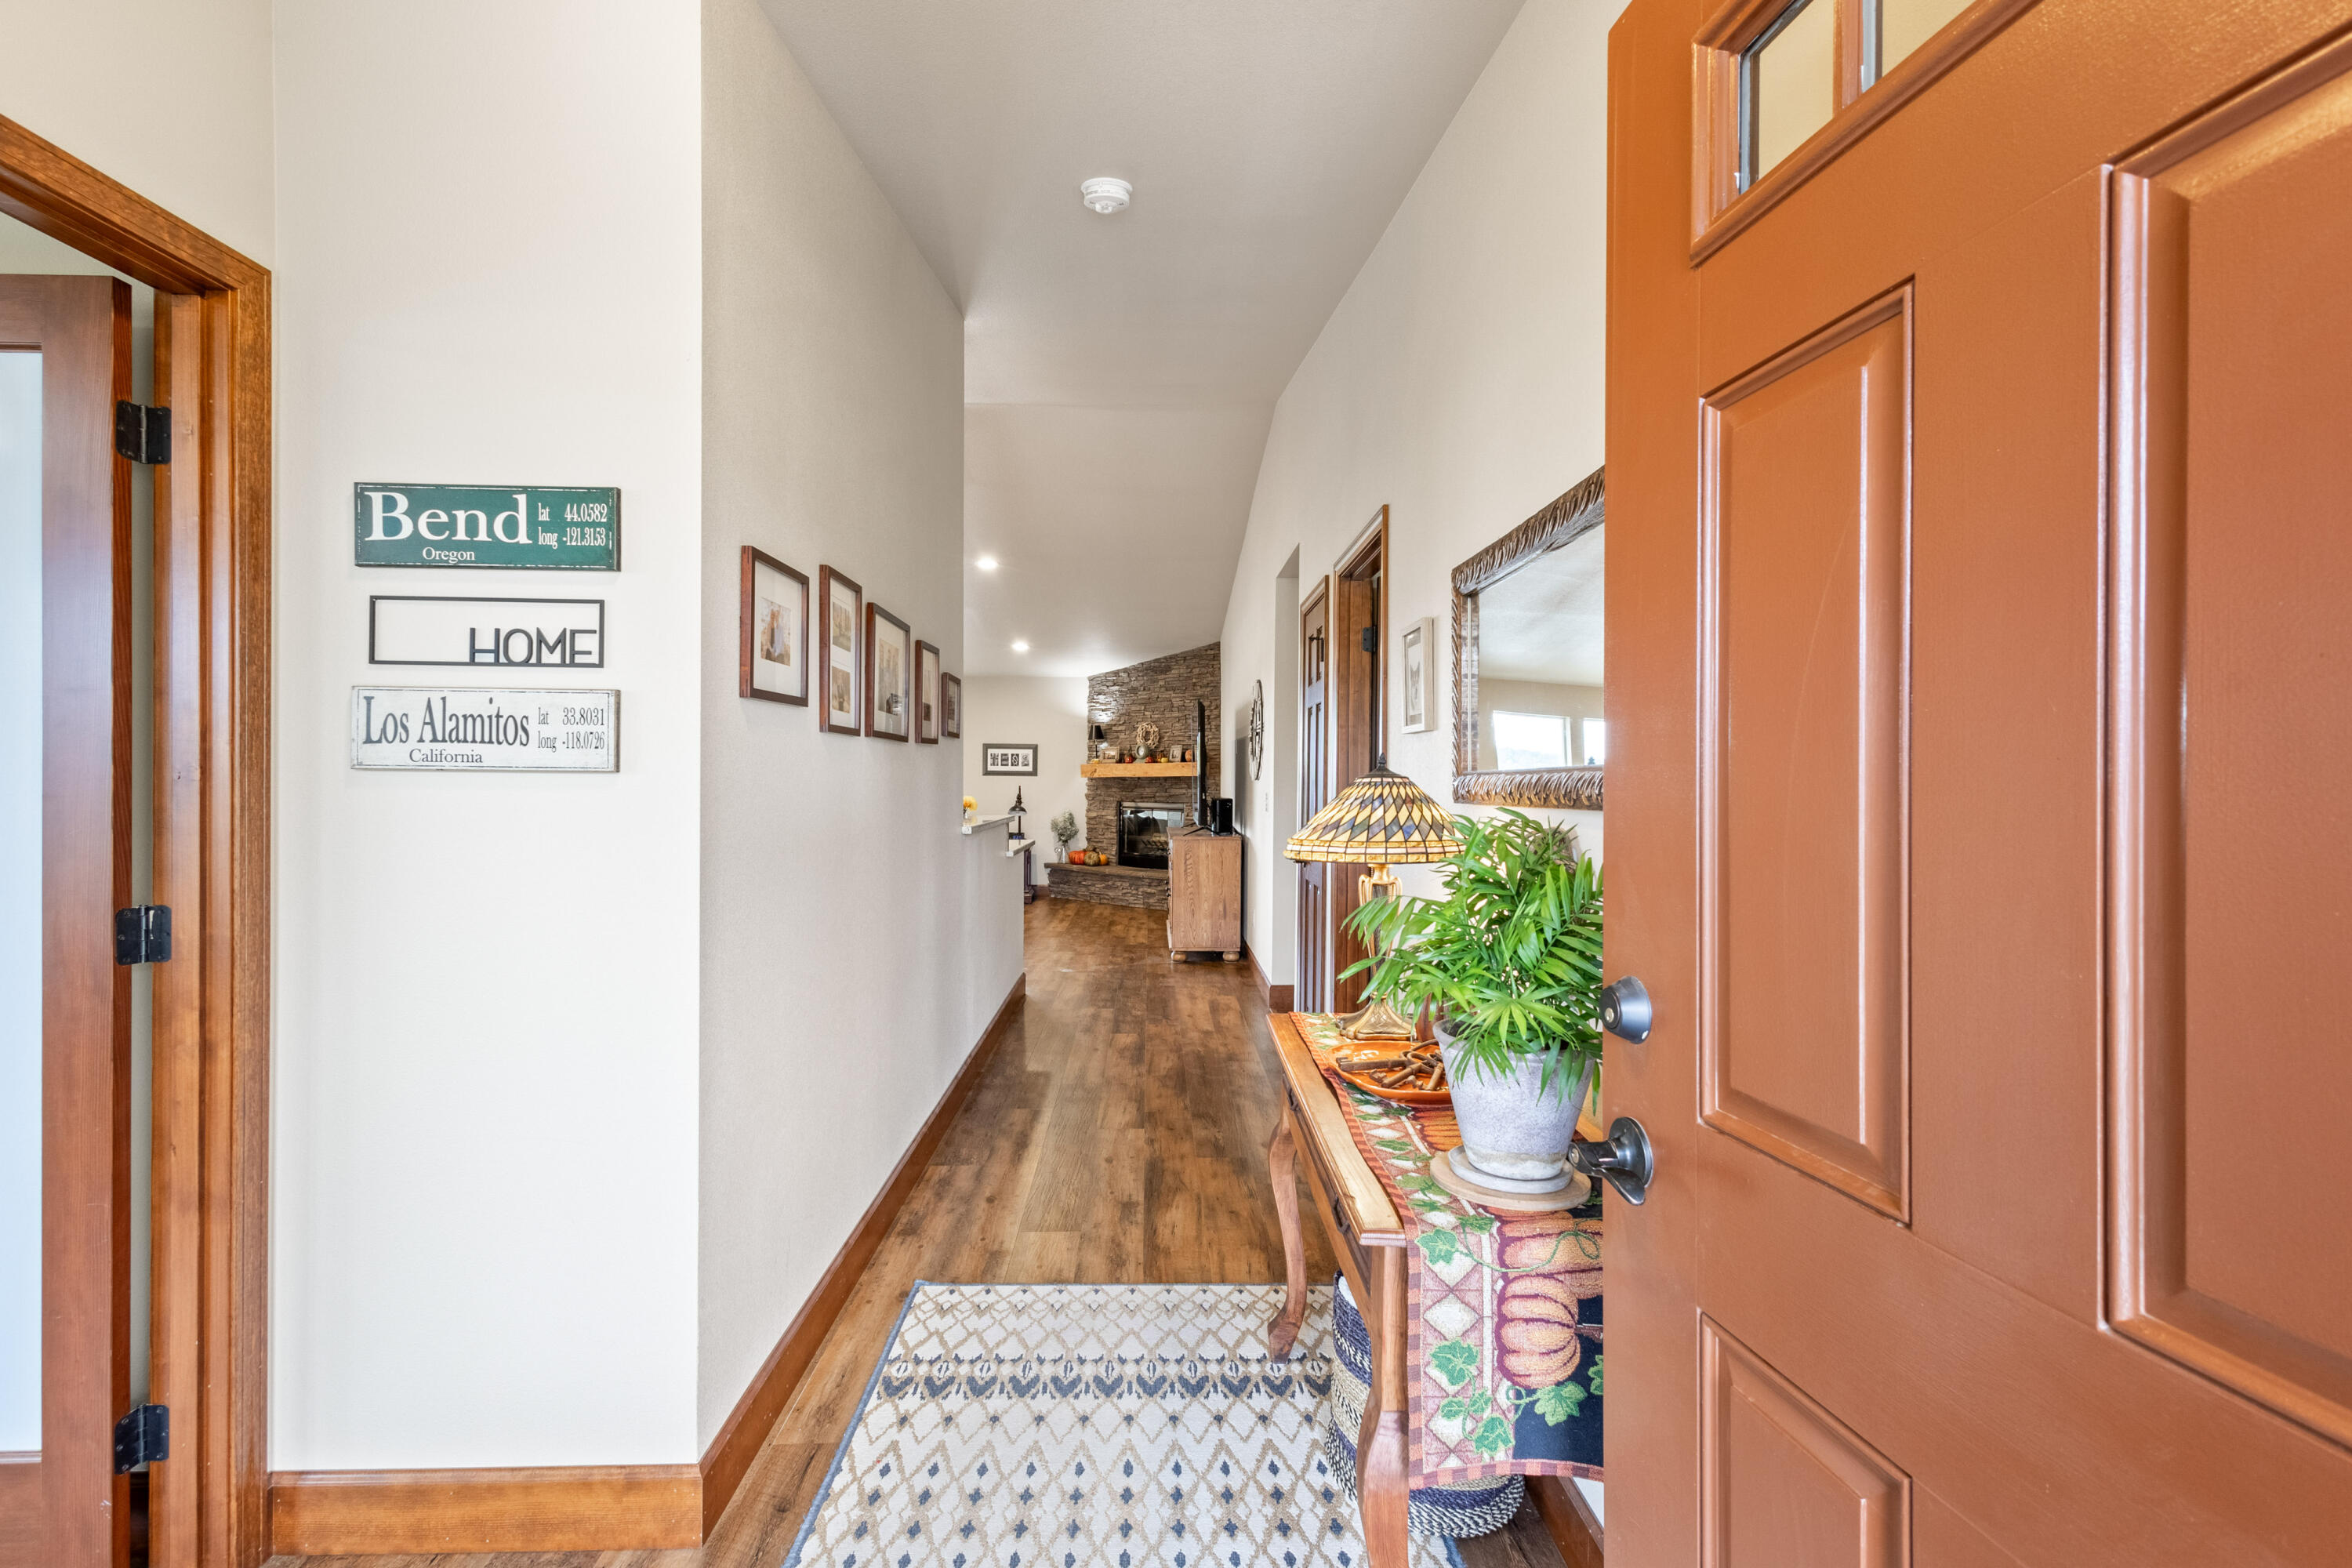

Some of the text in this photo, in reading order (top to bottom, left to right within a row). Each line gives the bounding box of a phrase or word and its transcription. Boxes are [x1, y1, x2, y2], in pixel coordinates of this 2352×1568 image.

[364, 491, 533, 545] Bend
[538, 502, 608, 522] lat 44.0582
[538, 526, 606, 550] long -121.3153
[422, 546, 476, 564] Oregon
[470, 627, 597, 666] HOME
[362, 695, 531, 747] Los Alamitos
[538, 706, 604, 726] lat 33.8031
[537, 730, 605, 753] long -118.0726
[408, 748, 484, 764] California
